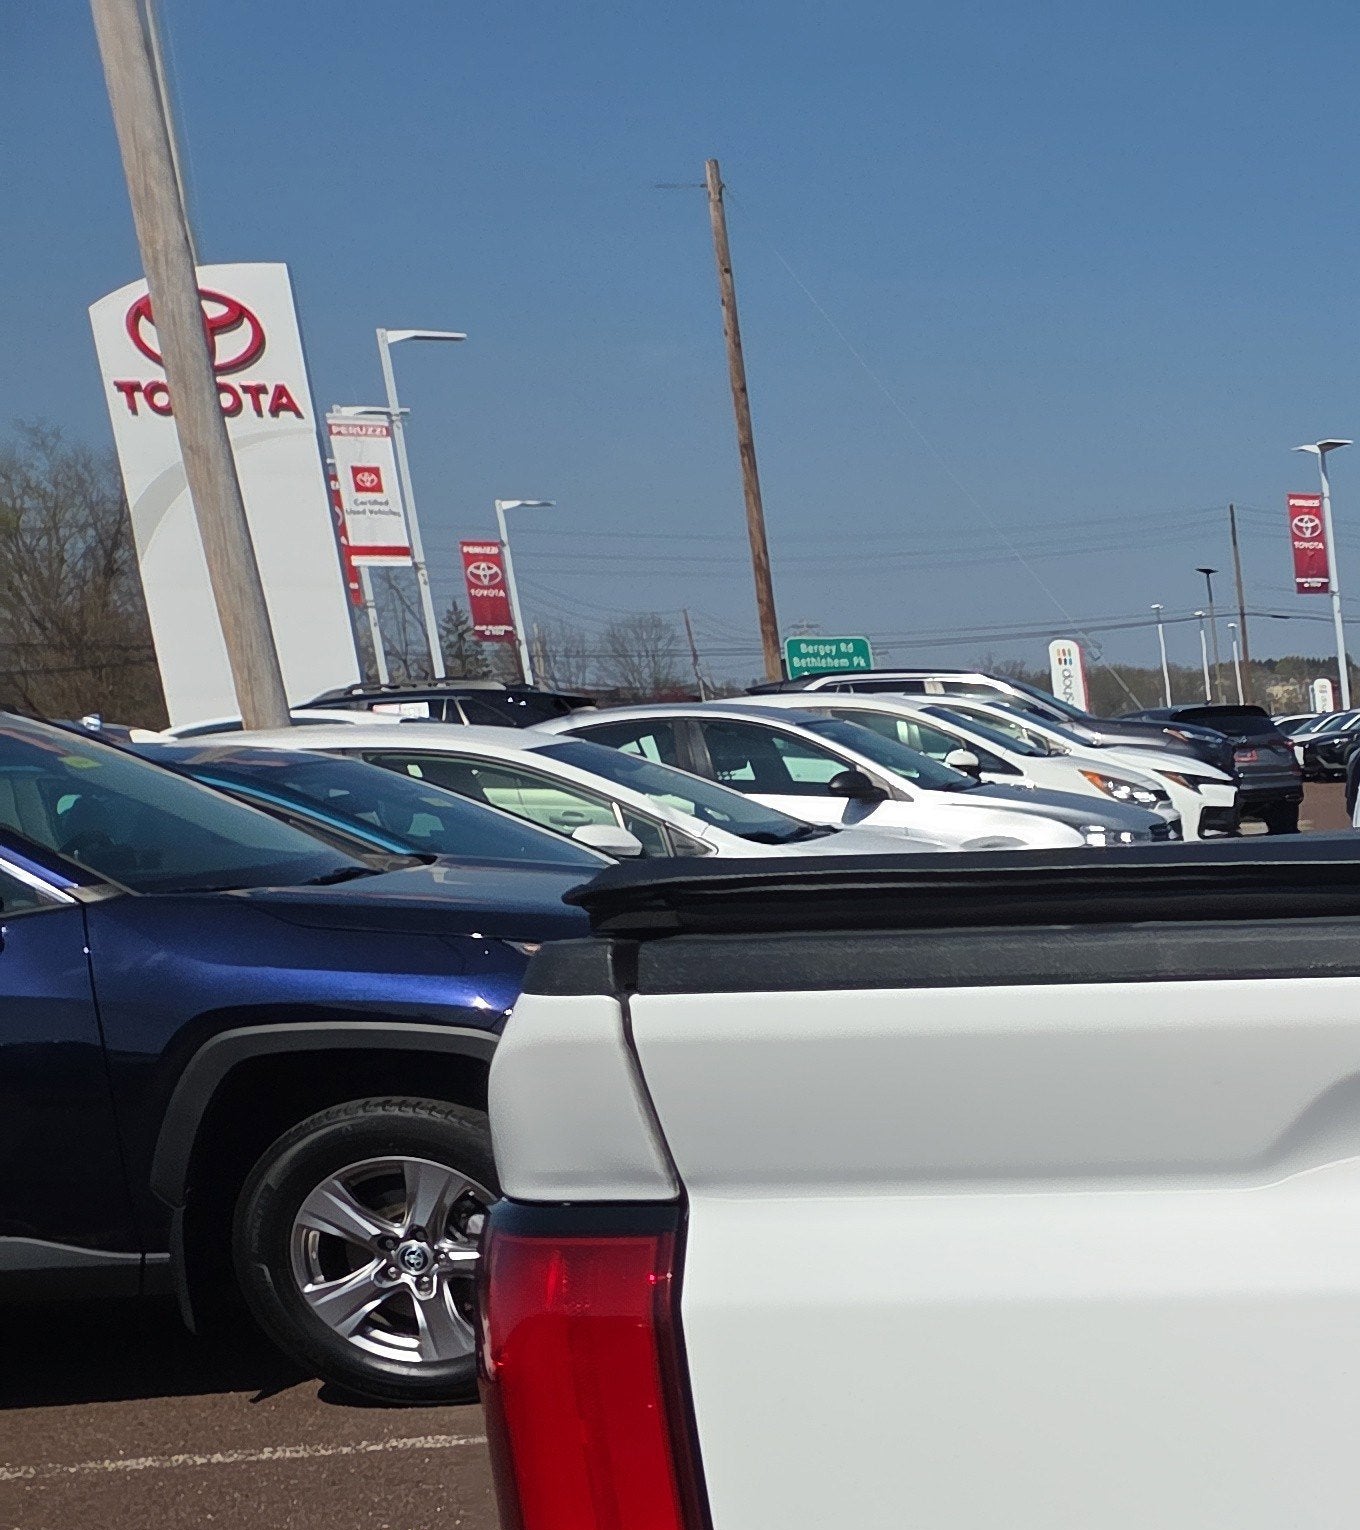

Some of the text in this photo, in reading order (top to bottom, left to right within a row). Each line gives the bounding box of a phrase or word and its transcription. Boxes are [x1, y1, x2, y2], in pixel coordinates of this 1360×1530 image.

[113, 379, 304, 420] TOOTA
[331, 425, 387, 435] PERUZZI
[470, 588, 506, 597] TOYOTA
[800, 642, 854, 655] Bergey Rd
[793, 656, 850, 668] Bethlehem
